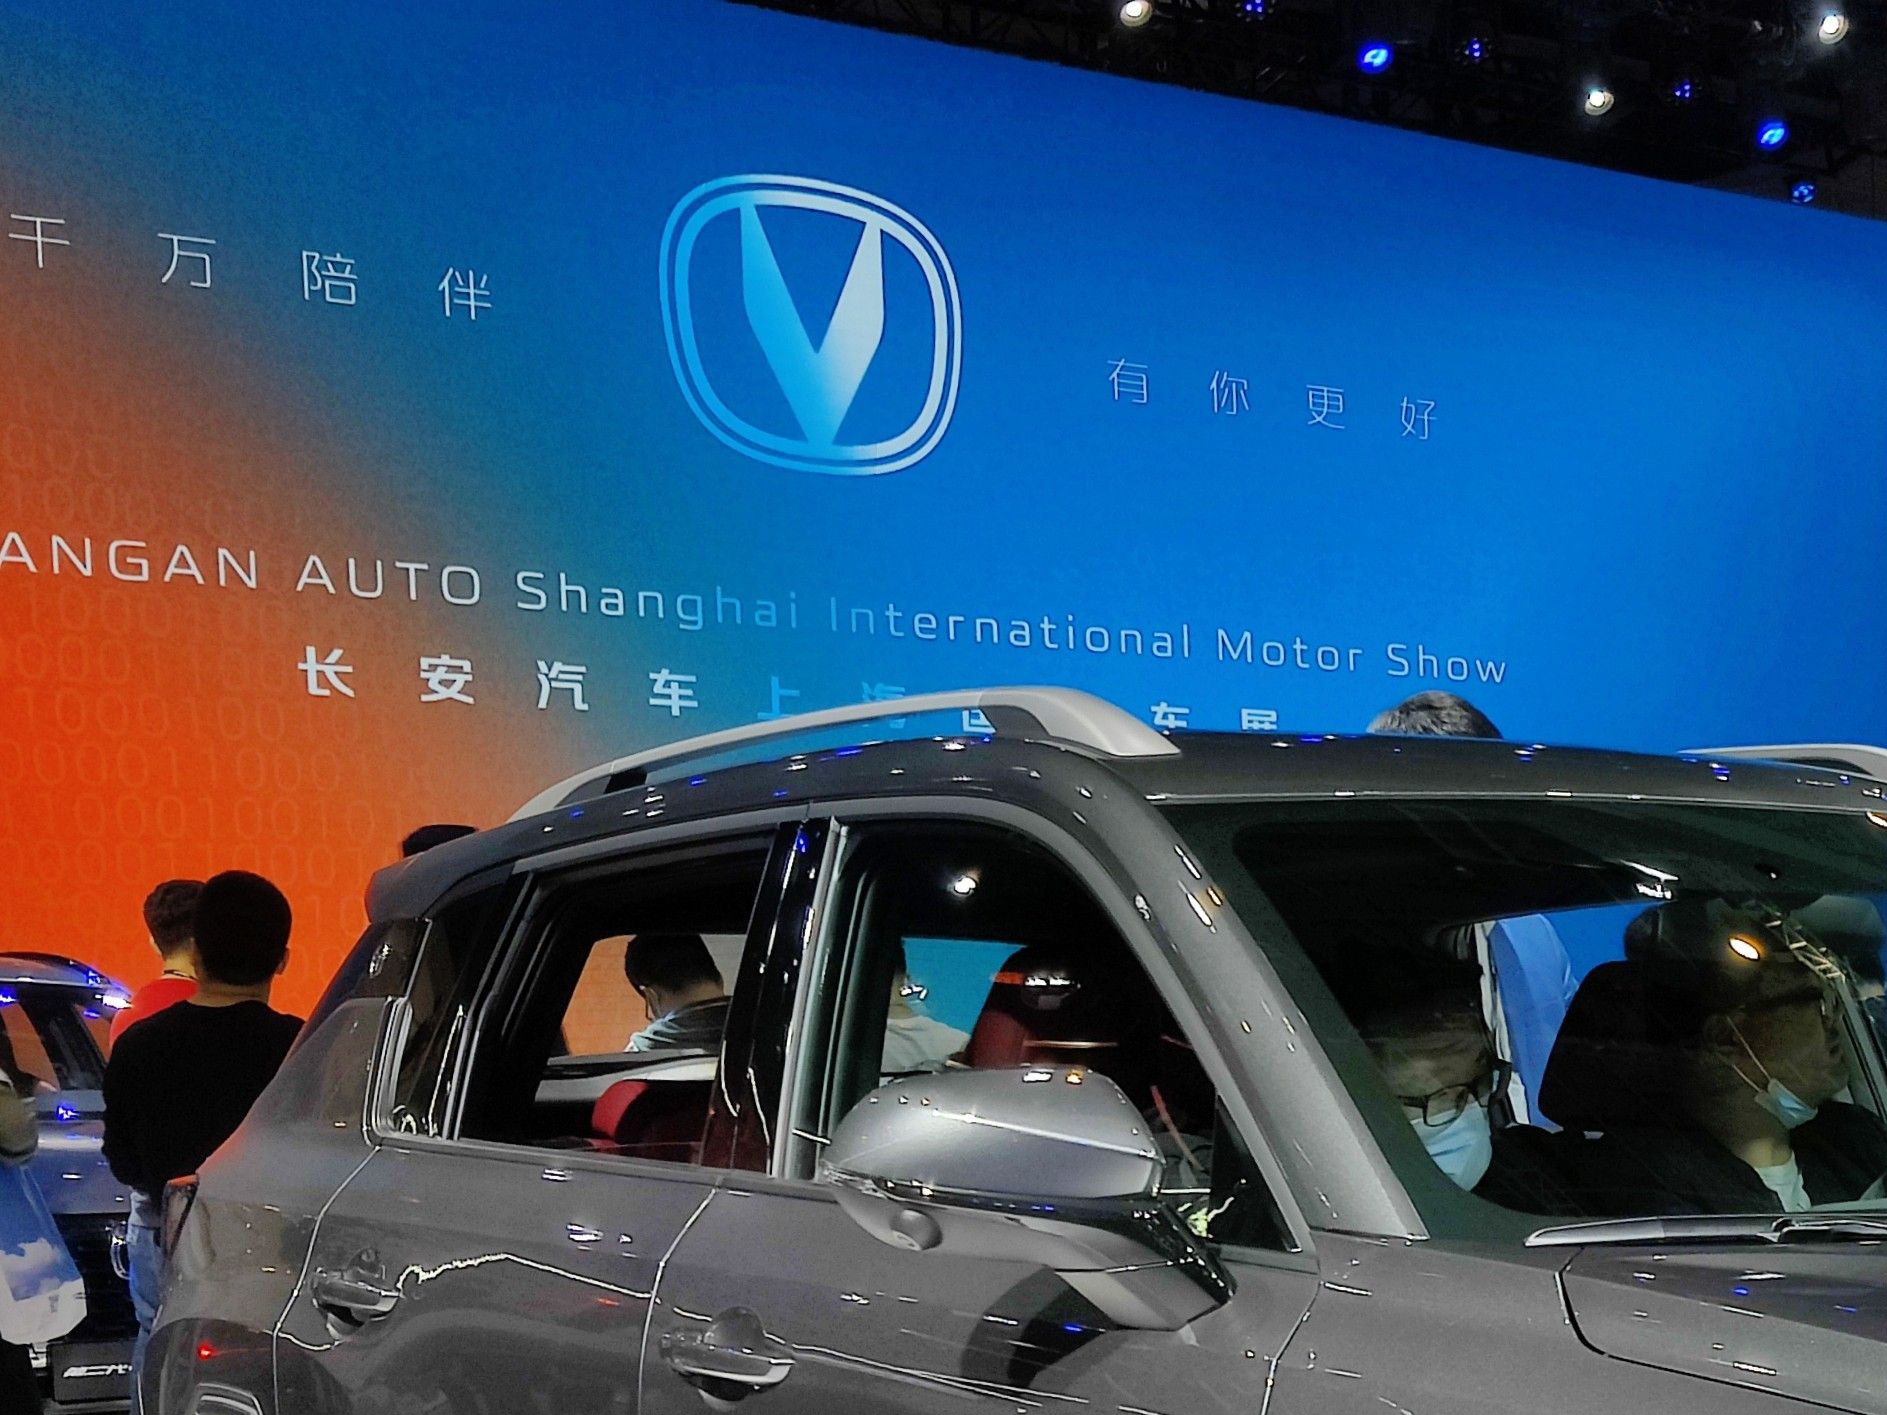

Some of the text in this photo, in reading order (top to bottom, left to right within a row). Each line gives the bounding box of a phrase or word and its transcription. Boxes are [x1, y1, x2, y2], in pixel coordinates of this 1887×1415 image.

[8, 212, 492, 321] 千万陪伴
[1106, 358, 1437, 440] 有你更好
[296, 553, 482, 605] AUTO
[515, 570, 798, 631] Shanghai
[829, 597, 1190, 659] International
[1216, 627, 1364, 672] Motor
[1387, 643, 1507, 684] Show
